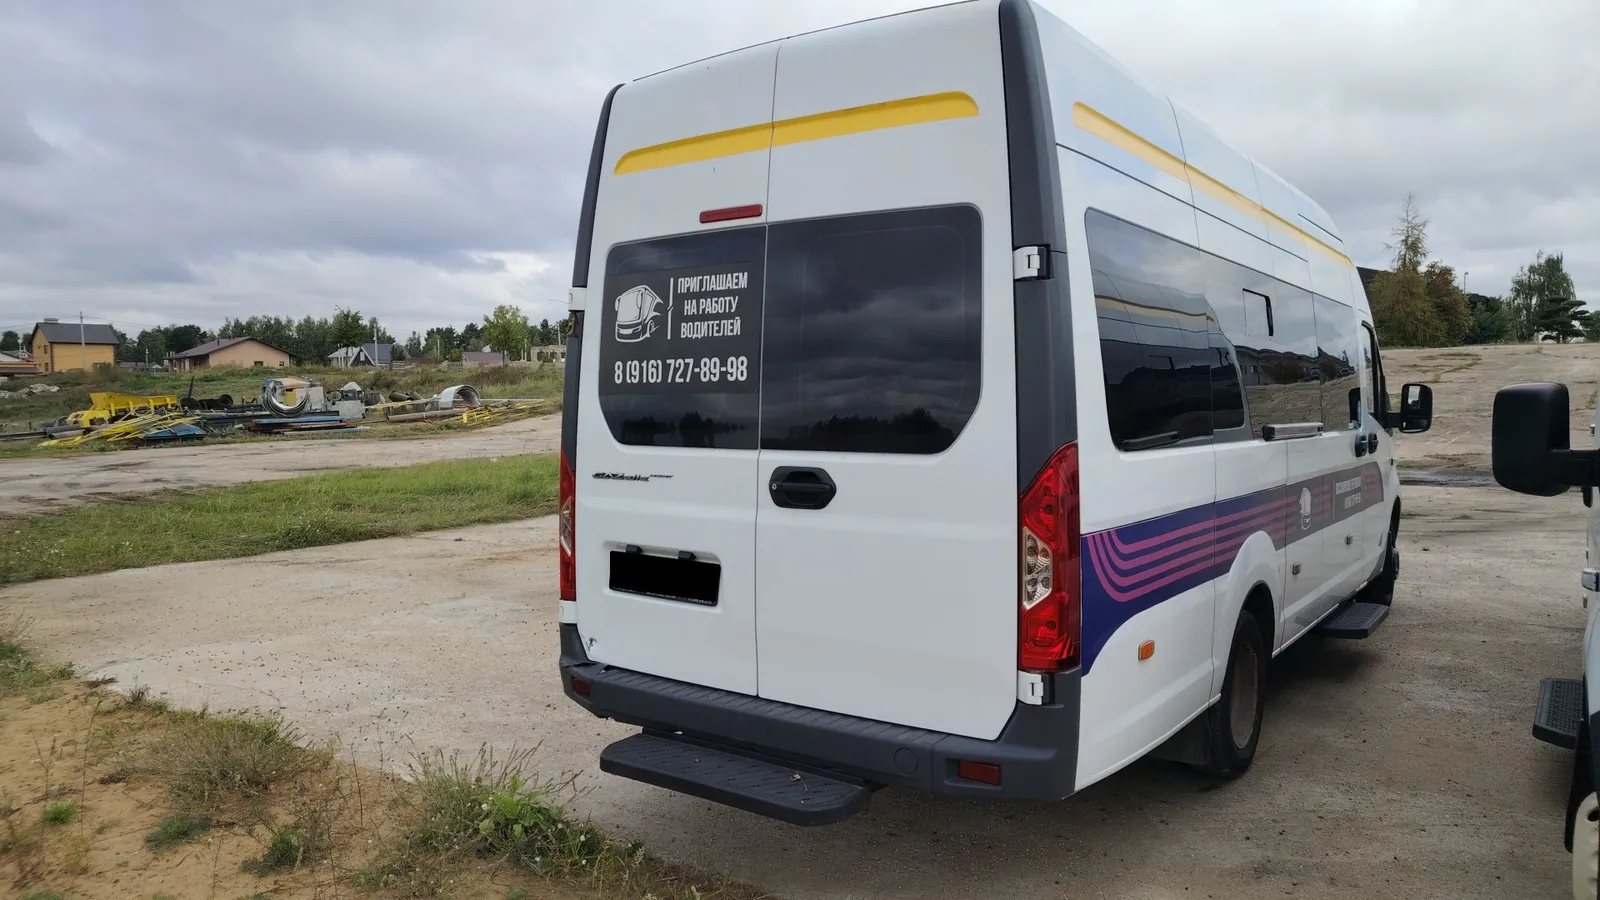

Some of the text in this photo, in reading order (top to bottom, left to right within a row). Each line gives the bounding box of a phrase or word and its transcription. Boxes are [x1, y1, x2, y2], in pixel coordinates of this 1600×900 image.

[677, 271, 748, 294] ПРИГЛАШАЕМ
[684, 296, 739, 316] НА РАБОТУ
[680, 316, 741, 339] ВОДИТЕЛЕЙ
[614, 356, 748, 384] 8 (916) 727-89-98
